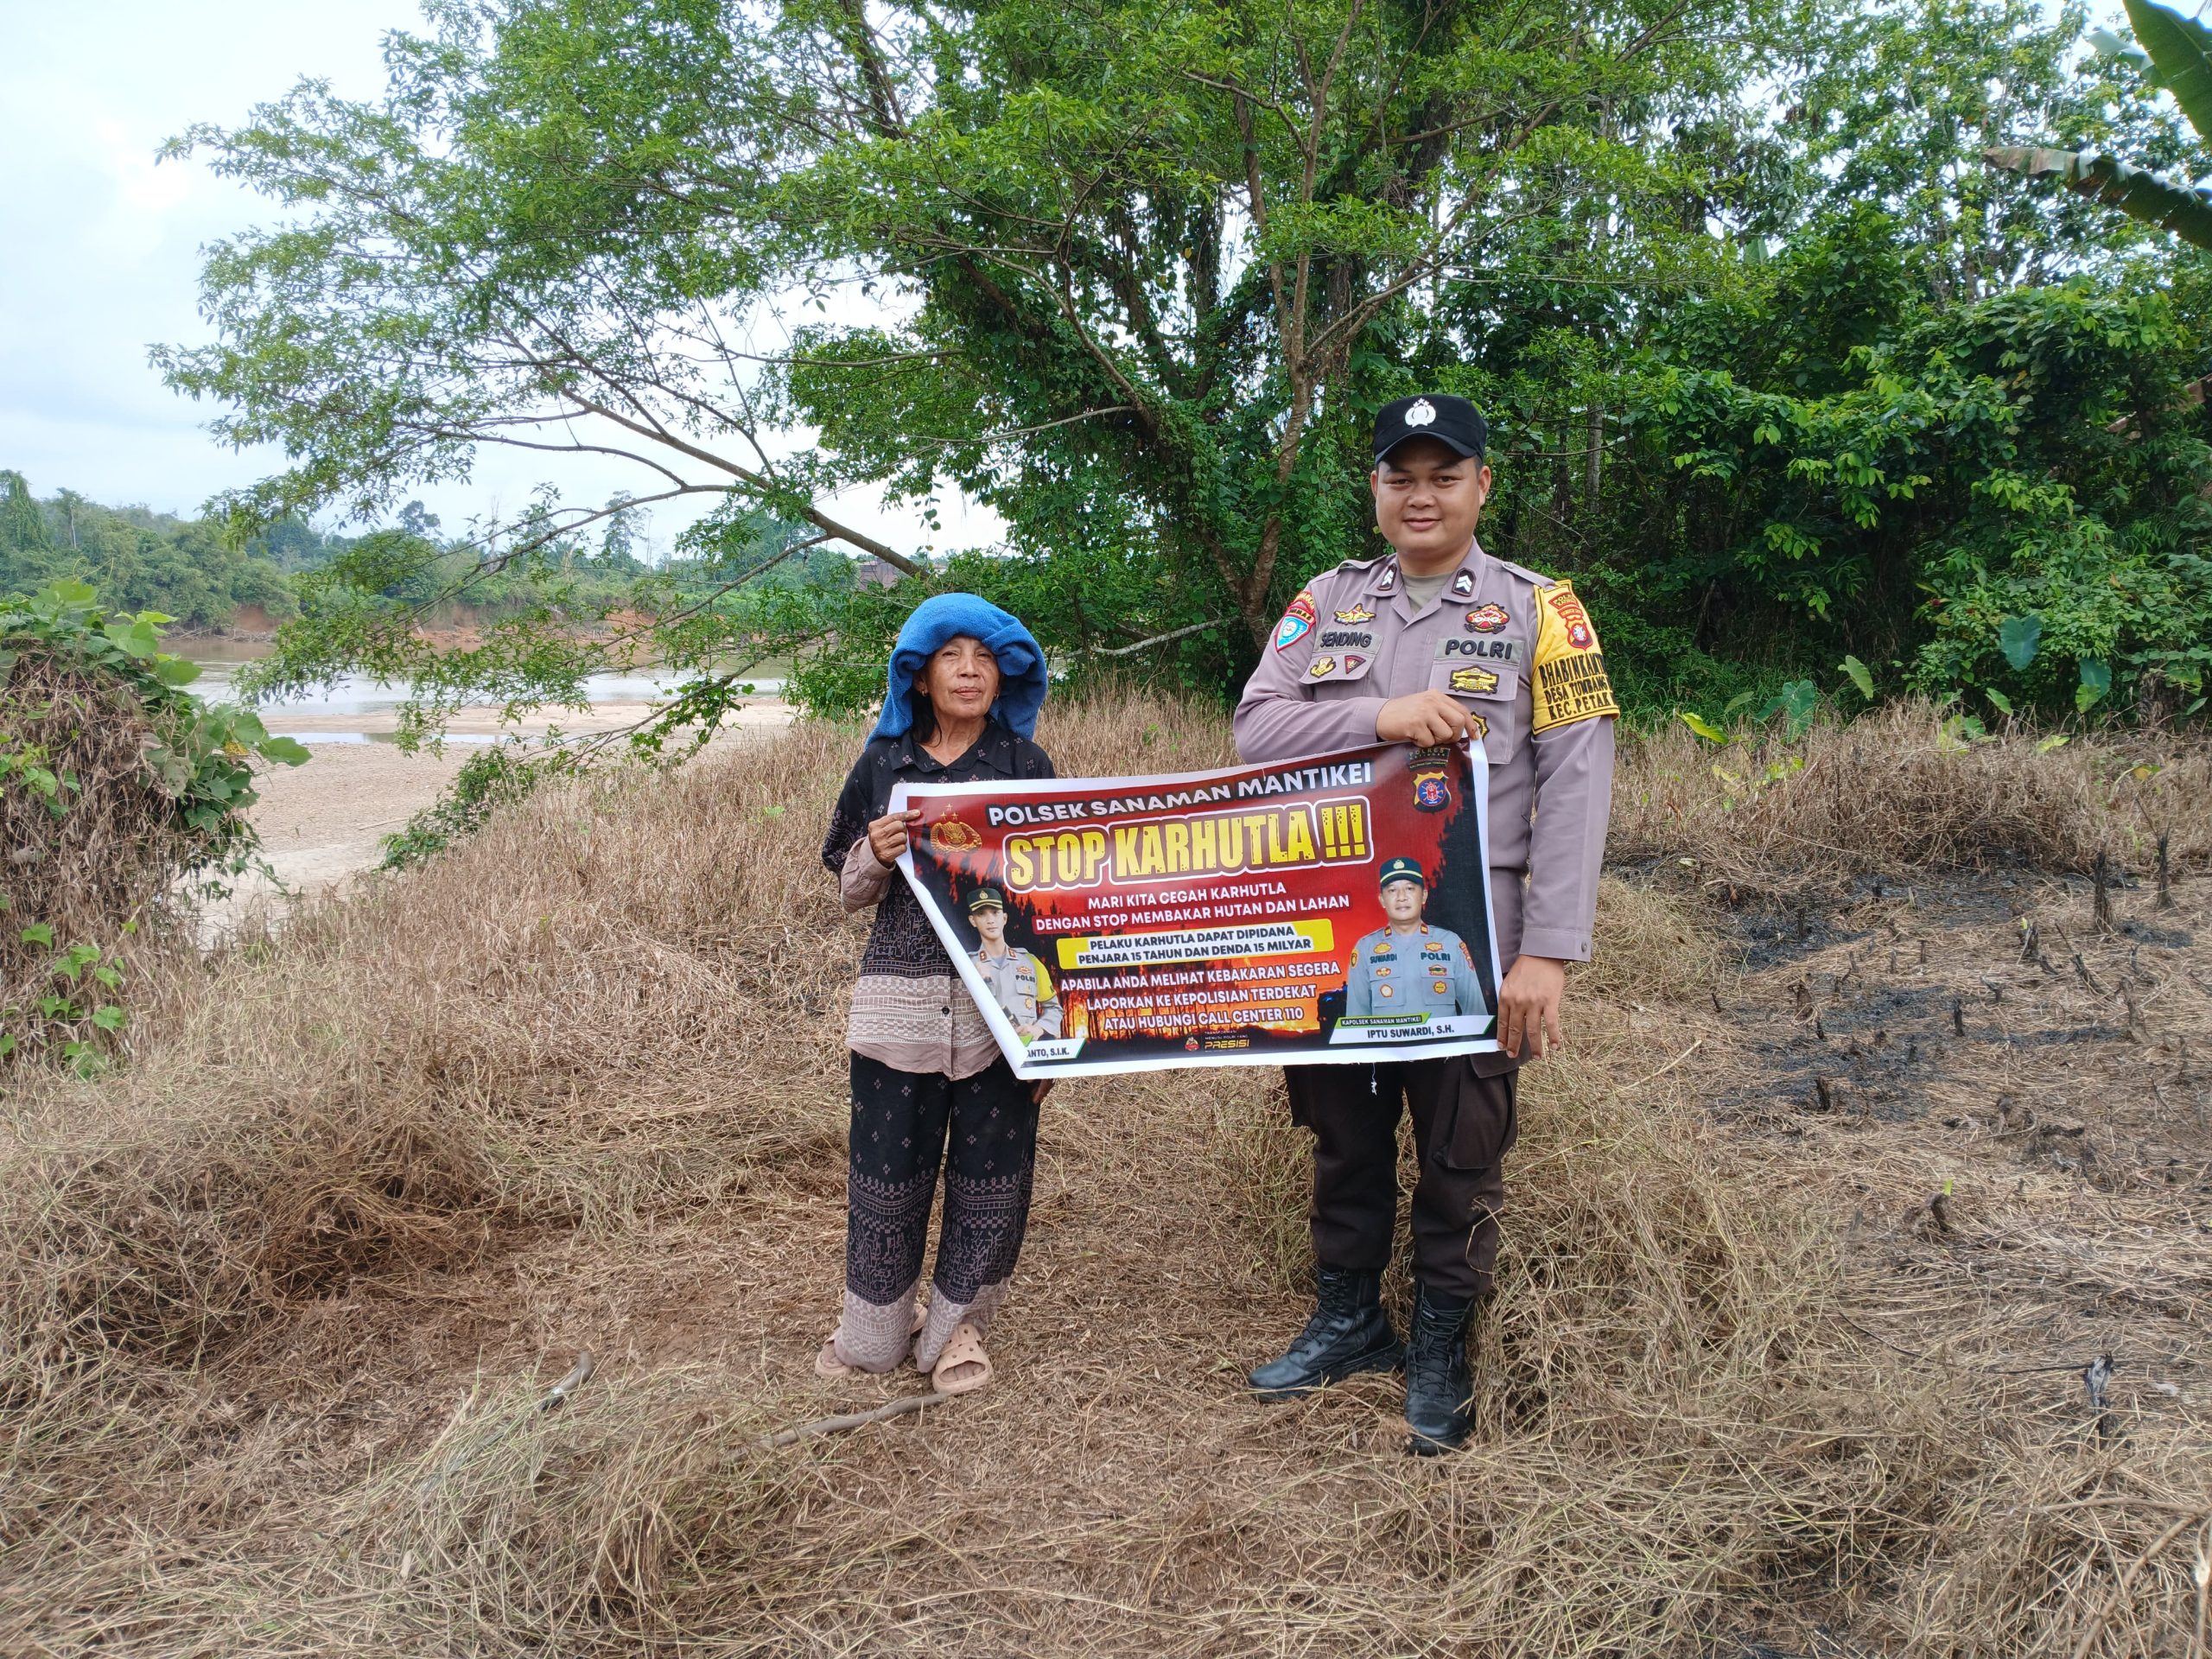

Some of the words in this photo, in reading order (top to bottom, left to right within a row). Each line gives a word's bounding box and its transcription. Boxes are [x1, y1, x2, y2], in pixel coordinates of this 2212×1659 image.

[1320, 632, 1372, 648] SENDING
[1445, 639, 1513, 659] POLRI
[1543, 684, 1569, 705] DESA
[1569, 676, 1608, 697] TUMBANG
[988, 803, 1089, 826] POLSEK
[1090, 785, 1231, 816] SANAMAN
[1238, 762, 1371, 798] MANTIKEI
[1010, 830, 1105, 886] STOP
[1114, 810, 1316, 878] KARHUTLA
[1320, 804, 1366, 858] !!!
[1088, 895, 1123, 910] MARI
[1127, 893, 1156, 907] KITA
[1159, 889, 1207, 904] CEGAH
[1211, 882, 1287, 900] KARHUTLA
[1036, 916, 1091, 931] DENGAN
[1094, 913, 1128, 927] STOP
[1131, 907, 1211, 925] MEMBAKAR
[1215, 902, 1262, 918] HUTAN
[1266, 899, 1297, 914] DAN
[1300, 895, 1350, 911] LAHAN
[1090, 938, 1133, 950] PELAKU
[1135, 932, 1195, 947] KARHUTLA
[1198, 931, 1234, 943] DAPAT
[1236, 925, 1295, 939] DIPIDANA
[1078, 953, 1129, 964] PENJARA
[1132, 951, 1142, 961] 15
[1145, 948, 1183, 961] TAHUN
[1185, 946, 1210, 957] DAN
[1211, 944, 1250, 956] DENDA
[1254, 942, 1265, 952] 15
[1268, 938, 1312, 951] MILYAR
[1370, 953, 1397, 964] SUWARDI
[1421, 951, 1451, 962] POLRI
[1061, 977, 1111, 991] APABILA
[1114, 975, 1149, 988] ANDA
[1151, 971, 1205, 987] MELIHAT
[1207, 965, 1286, 983] KEBAKARAN
[1288, 962, 1341, 977] SEGERA
[1087, 995, 1154, 1010] LAPORKAN
[1156, 994, 1171, 1007] KE
[1173, 989, 1249, 1006] KEPOLISIAN
[1250, 984, 1317, 1001] TERDEKAT
[1104, 1017, 1135, 1030] ATAU
[1138, 1013, 1196, 1028] HUBUNGI
[1198, 1011, 1230, 1025] CALL
[1232, 1008, 1283, 1023] CENTER
[1285, 1007, 1304, 1020] 110
[1367, 1028, 1388, 1039] IPTU
[1390, 1026, 1434, 1038] SUWARDI,
[1437, 1024, 1455, 1034] S.H.
[1050, 1046, 1070, 1057] S.I.K.
[1205, 1039, 1250, 1050] PRESISI
